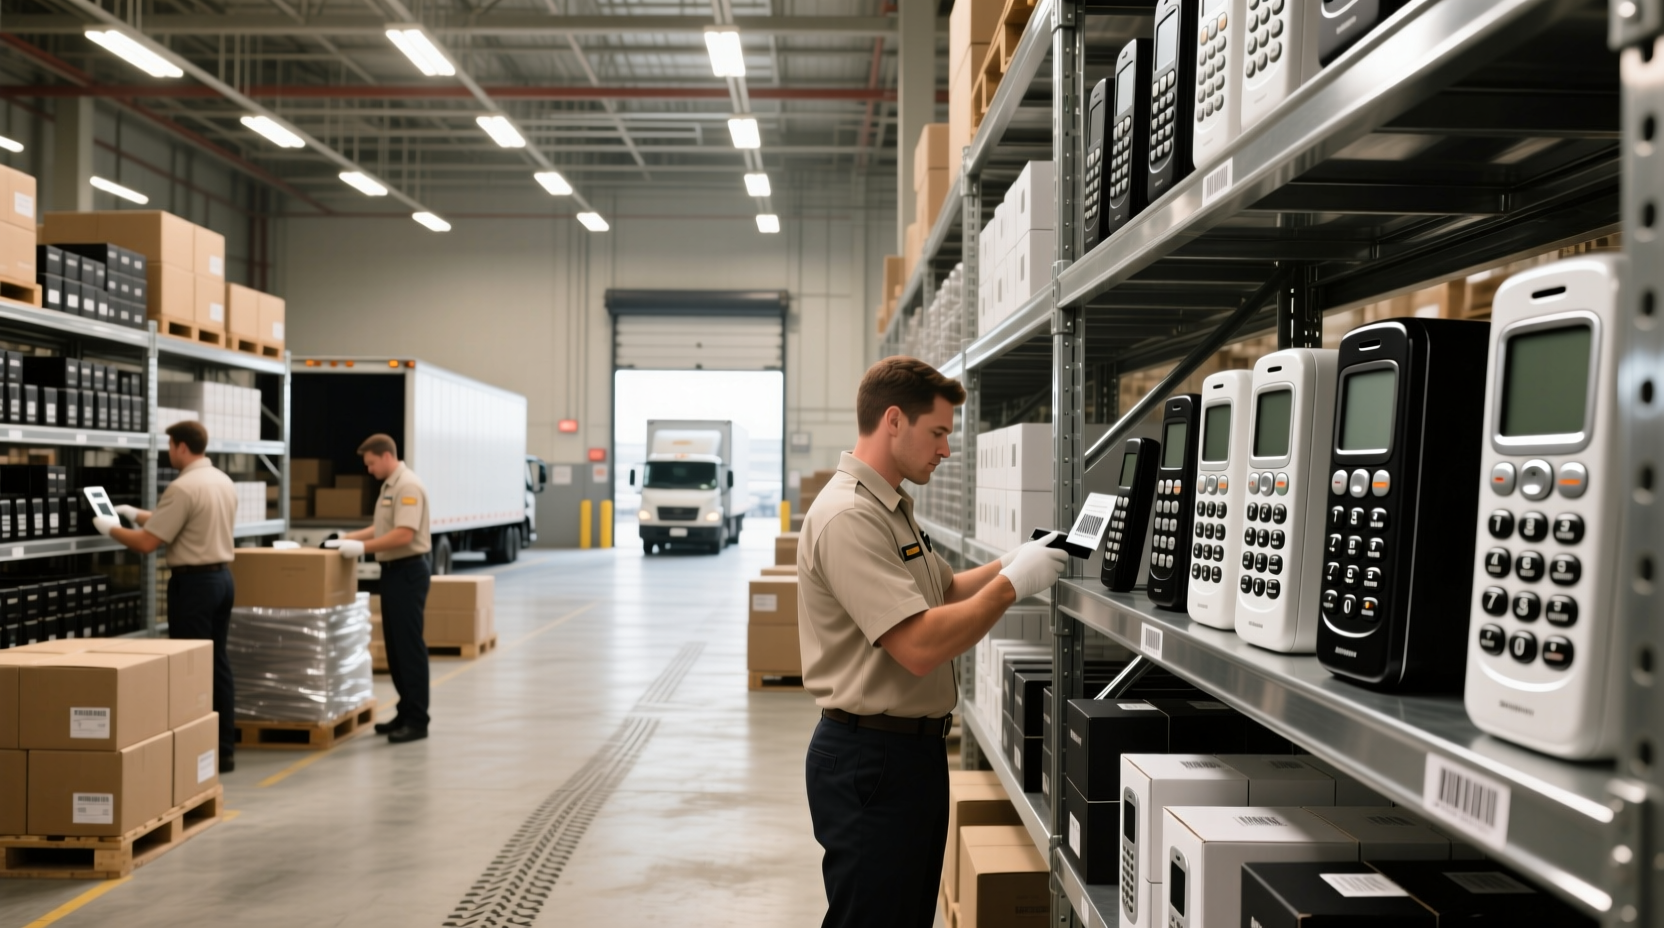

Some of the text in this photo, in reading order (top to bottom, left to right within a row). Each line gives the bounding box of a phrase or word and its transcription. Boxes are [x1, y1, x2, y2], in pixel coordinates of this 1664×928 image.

[1493, 515, 1502, 532] 1
[1343, 599, 1352, 614] 0
[1486, 592, 1499, 609] 7
[1514, 637, 1525, 657] 0
